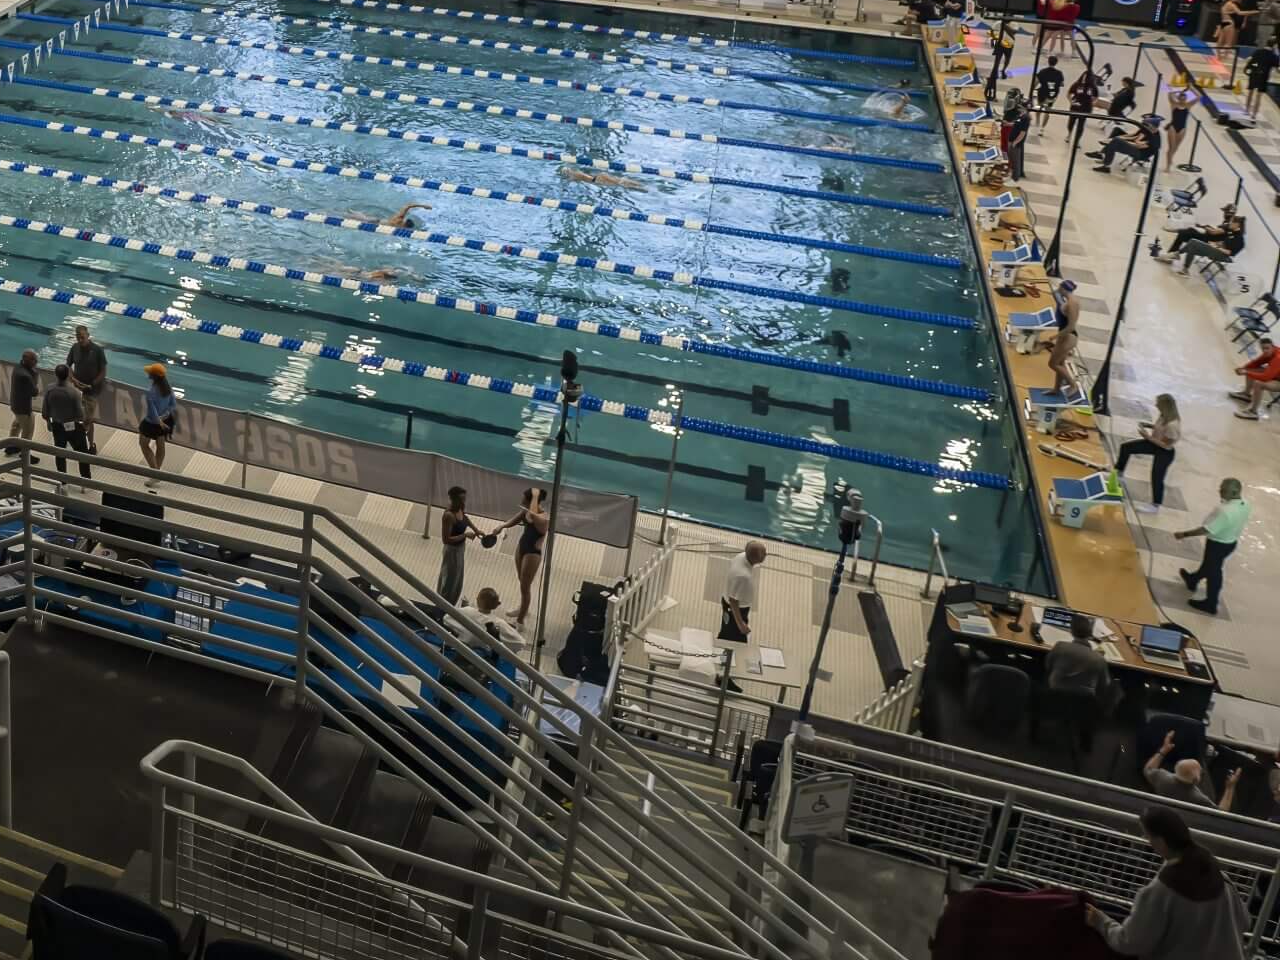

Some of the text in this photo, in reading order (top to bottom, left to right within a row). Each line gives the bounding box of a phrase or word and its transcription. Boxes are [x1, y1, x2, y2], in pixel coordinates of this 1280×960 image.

[989, 213, 996, 222] 5
[1044, 412, 1052, 423] 8
[1070, 507, 1081, 519] 9
